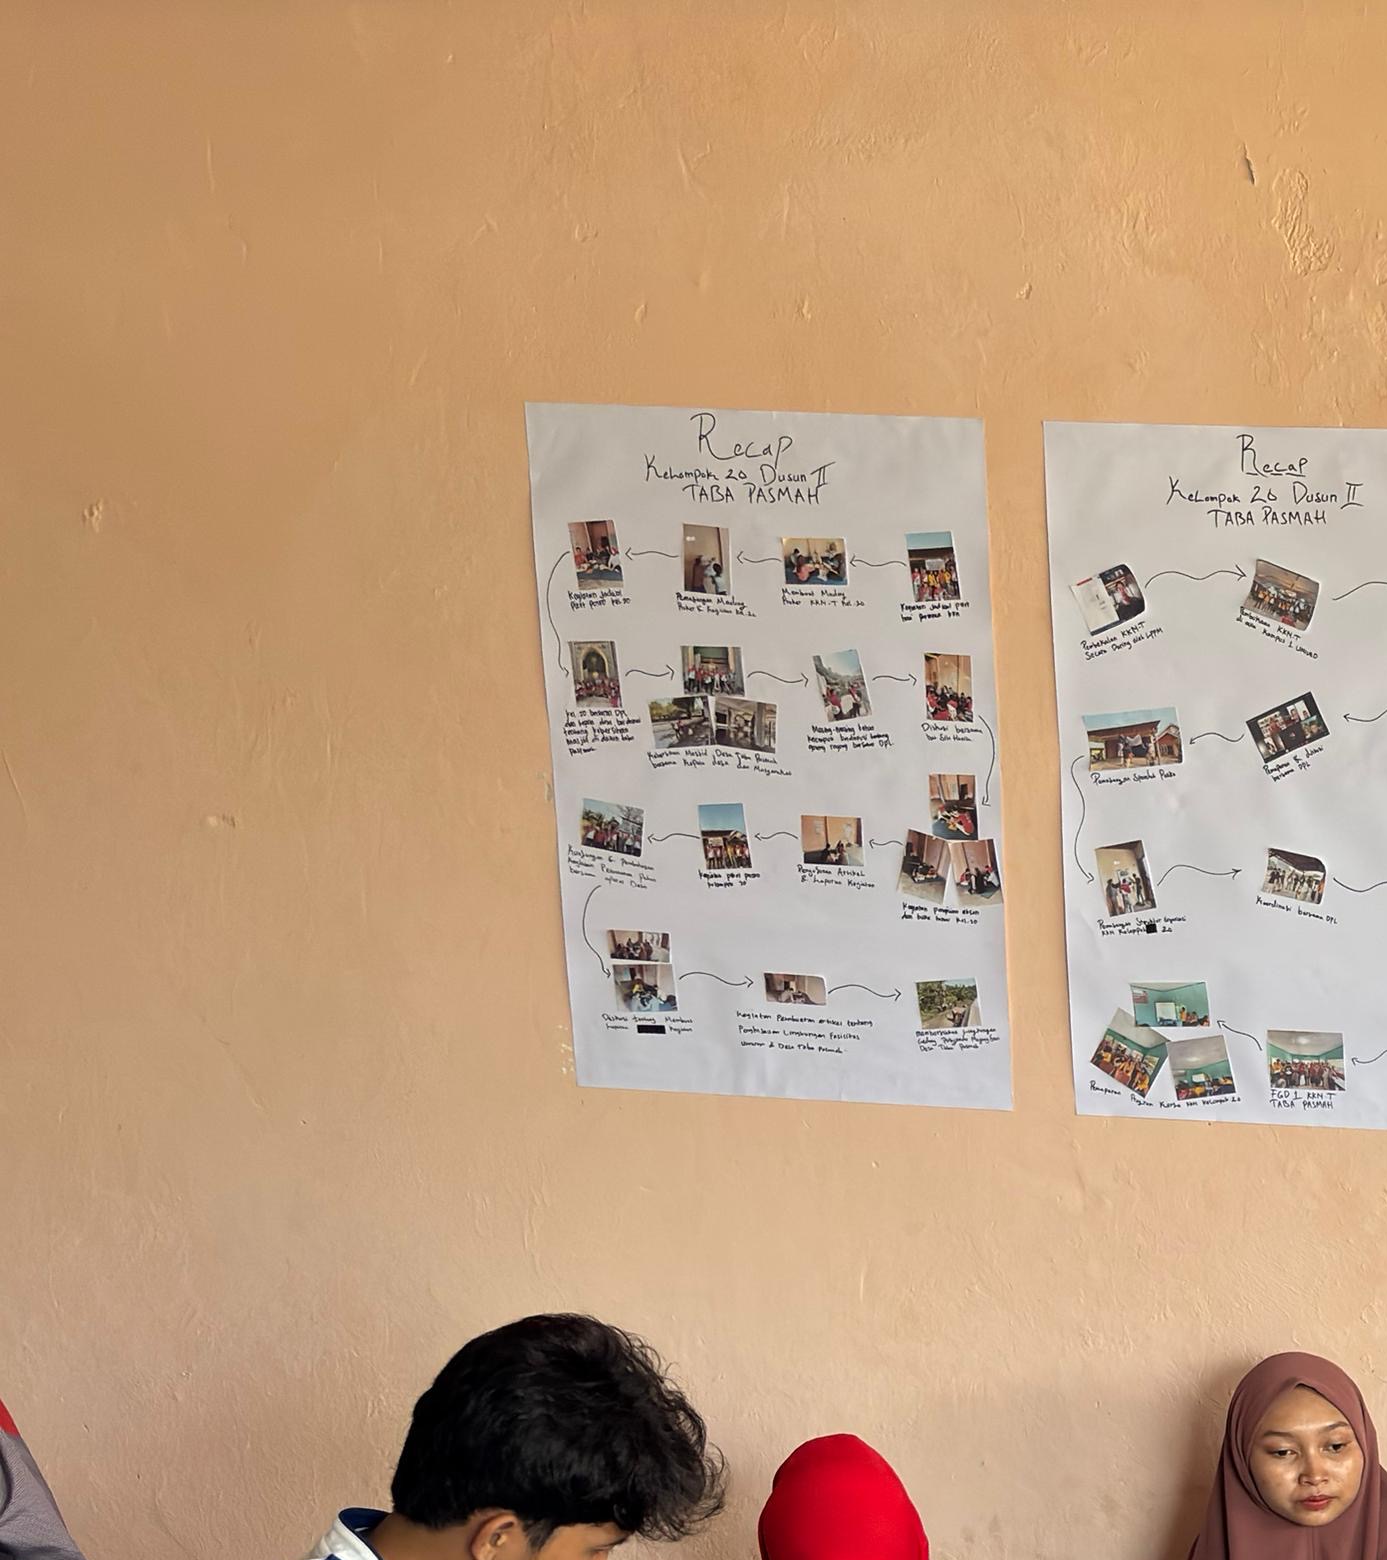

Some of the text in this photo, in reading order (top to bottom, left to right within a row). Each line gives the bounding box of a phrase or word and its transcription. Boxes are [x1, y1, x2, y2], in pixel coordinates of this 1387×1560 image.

[690, 412, 792, 470] Recap
[1236, 434, 1308, 477] Recap
[725, 469, 747, 480] 20
[760, 464, 806, 486] Dusun
[683, 483, 819, 504] TABA PASMAH
[1293, 481, 1338, 504] Dusun
[1207, 506, 1327, 528] TABA PASMAH
[1269, 1099, 1334, 1110] TABA PASMAH
[1270, 1089, 1290, 1100] FGD
